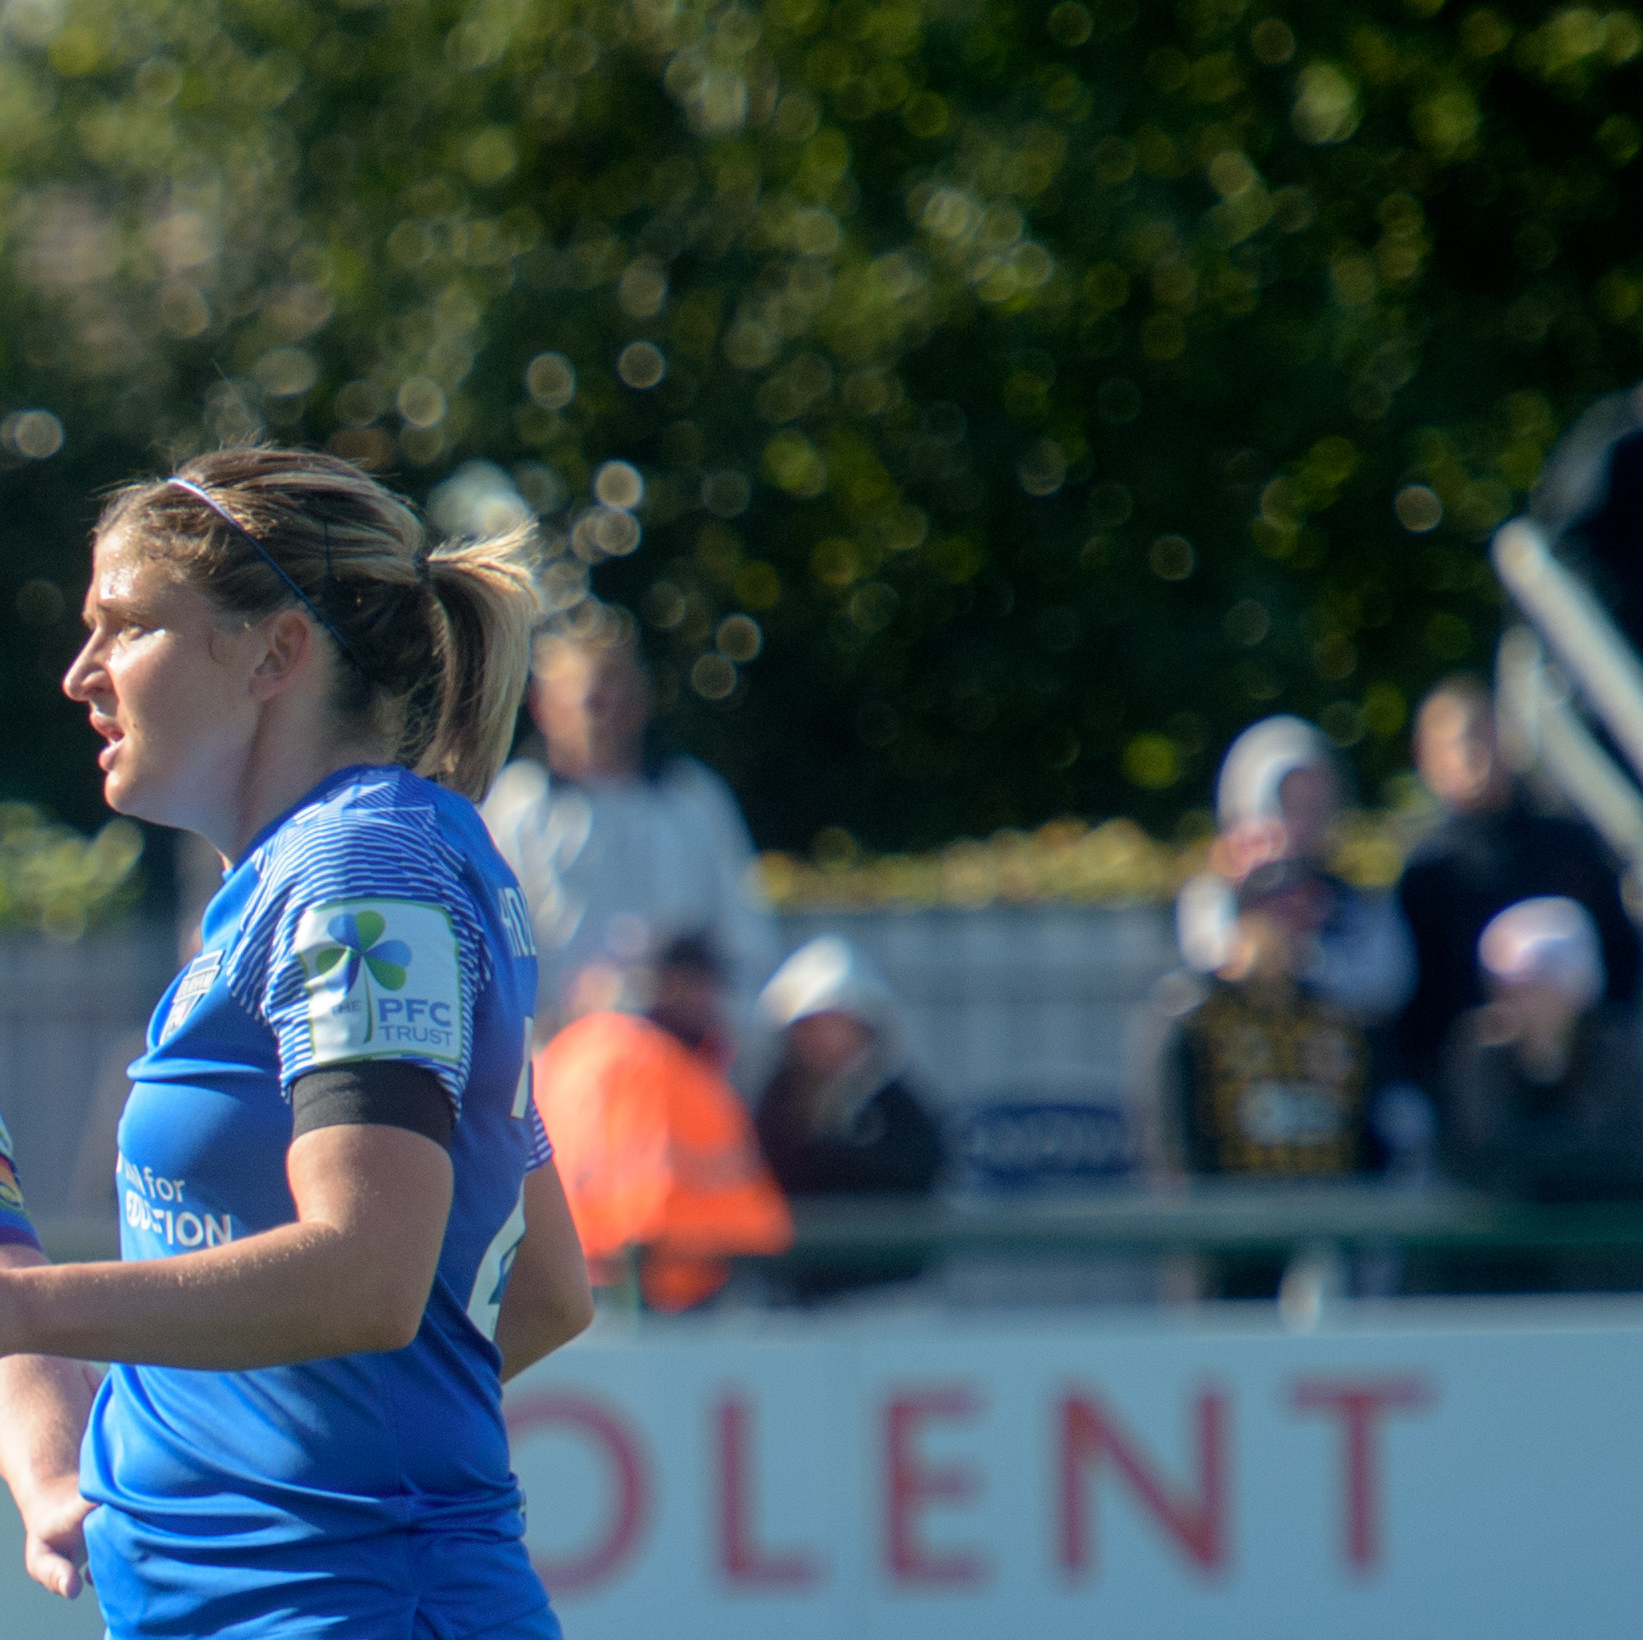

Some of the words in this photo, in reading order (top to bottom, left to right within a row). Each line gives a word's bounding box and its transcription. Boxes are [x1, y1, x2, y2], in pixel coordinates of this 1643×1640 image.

[377, 998, 452, 1028] PFC
[379, 1025, 453, 1047] TRUST
[143, 1166, 185, 1203] for
